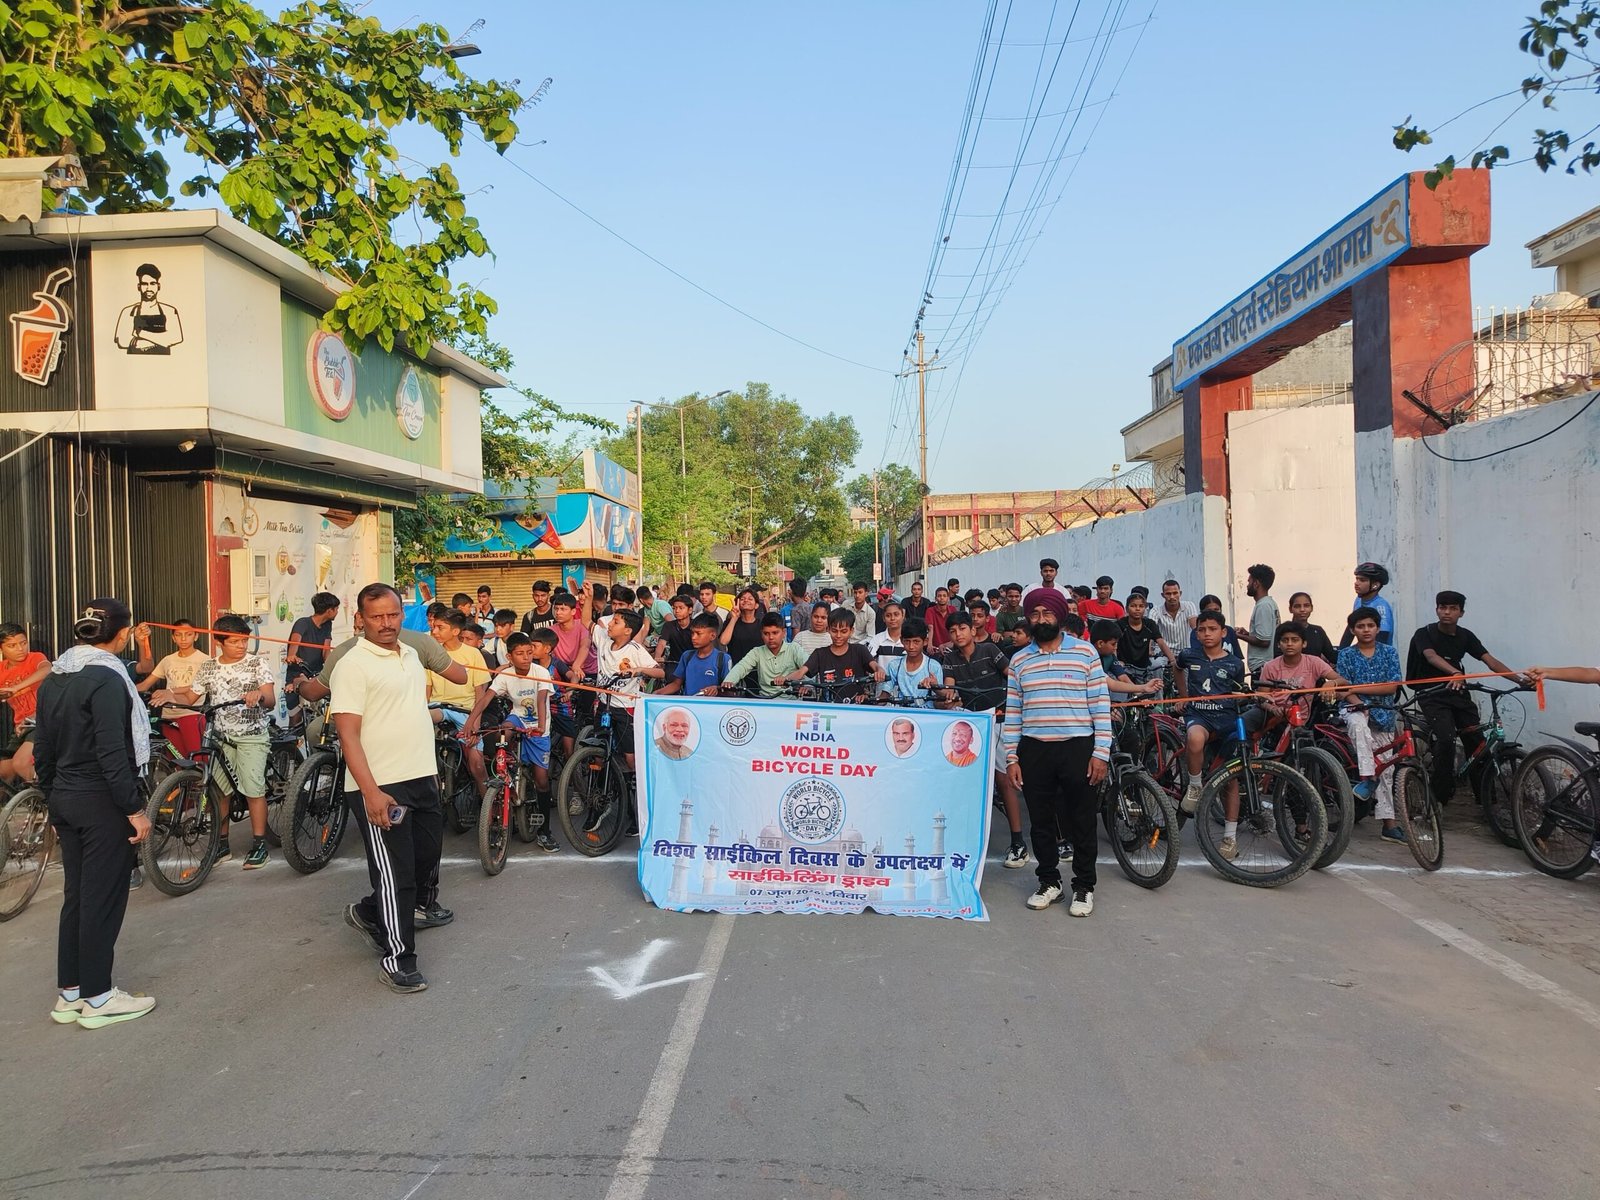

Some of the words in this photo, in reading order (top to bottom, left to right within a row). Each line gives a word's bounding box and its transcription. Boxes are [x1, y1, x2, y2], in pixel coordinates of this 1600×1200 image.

[1188, 325, 1222, 370] एकलव्य
[264, 520, 278, 531] Milk
[278, 522, 288, 532] Tea
[533, 619, 555, 630] WHAT
[1202, 678, 1211, 692] 4
[795, 732, 836, 742] INDIA
[781, 745, 850, 760] WORLD
[751, 760, 834, 775] BICYCLE
[840, 764, 878, 777] DAY
[792, 785, 812, 800] WORLD
[813, 785, 835, 801] BICYCLE
[653, 840, 697, 858] विश्व
[704, 844, 782, 864] साईकिल
[789, 847, 840, 866] दिवस
[846, 849, 868, 868] के
[873, 854, 945, 871] उपलक्ष्य
[950, 853, 970, 871] में
[728, 868, 836, 885] साईकिलिंग
[841, 874, 892, 888] ड्राइव
[767, 890, 792, 898] जून
